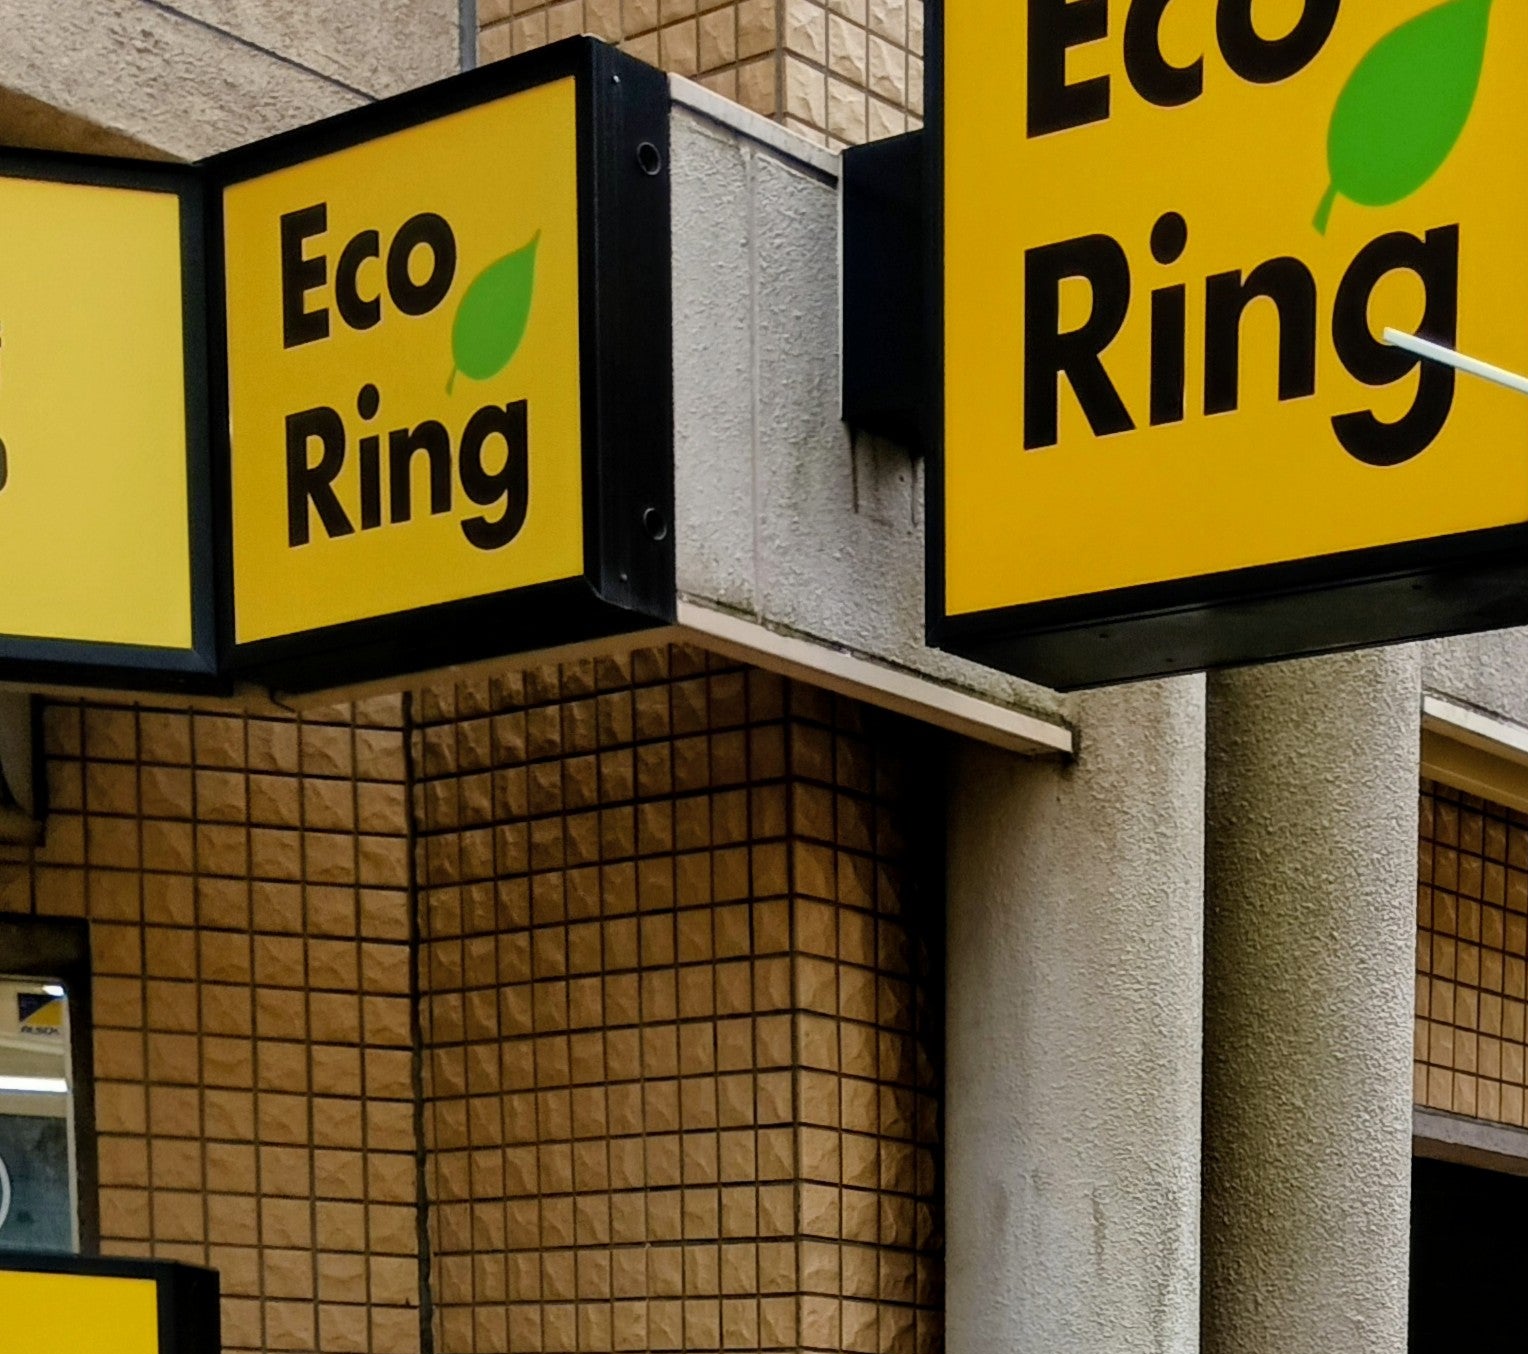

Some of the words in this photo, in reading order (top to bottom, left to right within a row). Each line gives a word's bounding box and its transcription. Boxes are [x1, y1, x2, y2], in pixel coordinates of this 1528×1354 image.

[279, 201, 458, 350] Eco
[1022, 210, 1461, 468] Ring
[284, 383, 530, 551] Ring
